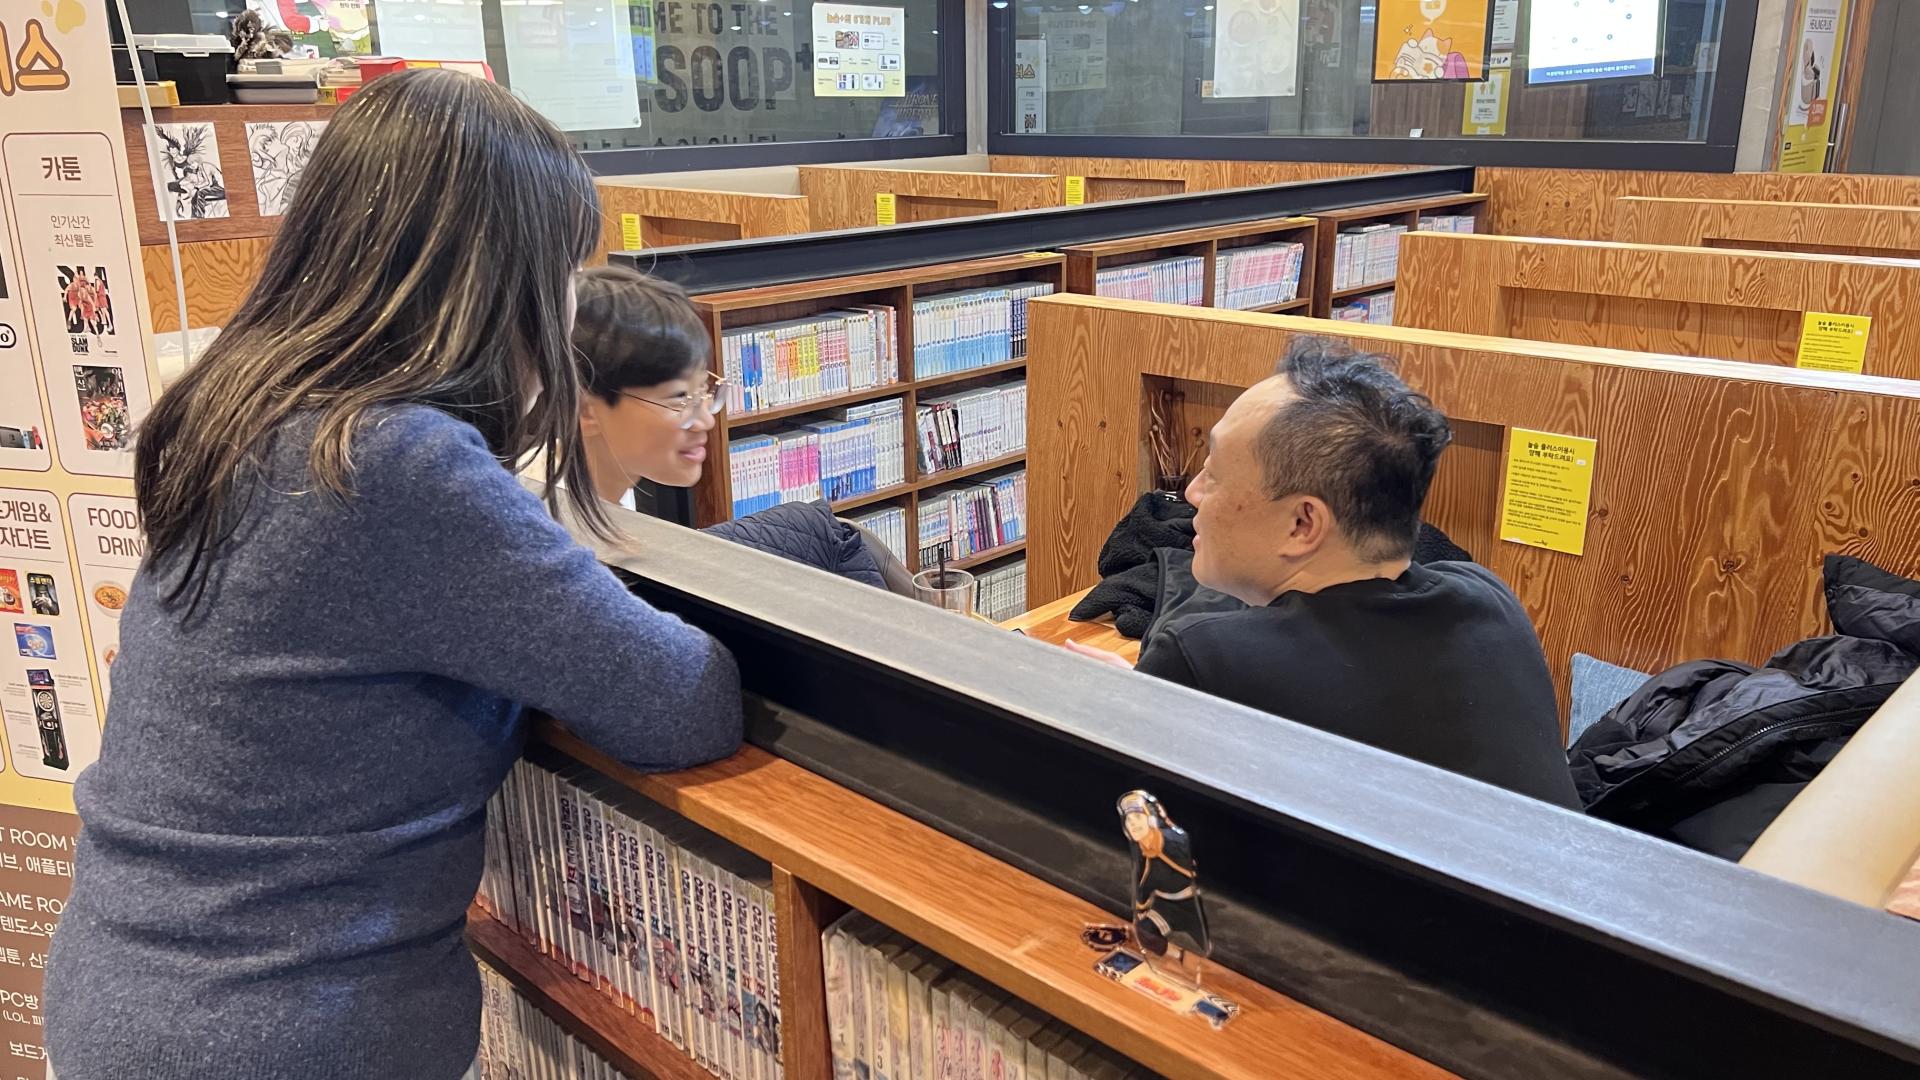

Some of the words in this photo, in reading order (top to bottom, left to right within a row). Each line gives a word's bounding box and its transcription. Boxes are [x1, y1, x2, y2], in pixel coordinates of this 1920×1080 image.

[691, 3, 724, 35] TO
[731, 4, 779, 36] THE
[41, 156, 82, 181] 카툰
[50, 215, 91, 229] 인기신간
[54, 233, 94, 248] 최신웹툰
[71, 337, 88, 346] SLAM
[72, 345, 89, 353] DUNK
[88, 507, 137, 530] FOOD
[98, 536, 145, 557] DRIN
[10, 828, 67, 851] ROOM
[628, 836, 638, 862] ONE
[26, 856, 75, 878] 애플티
[644, 844, 654, 871] ONE
[682, 870, 691, 896] ONE
[694, 877, 704, 904] ONE
[36, 896, 67, 914] RO
[708, 883, 717, 910] ONE
[722, 890, 732, 919] ONE
[737, 898, 747, 927] ONE
[752, 906, 762, 934] ONE
[725, 919, 735, 965] PIECE
[740, 927, 750, 974] PIECE
[755, 935, 765, 982] PIECE
[0, 989, 38, 1010] PC방
